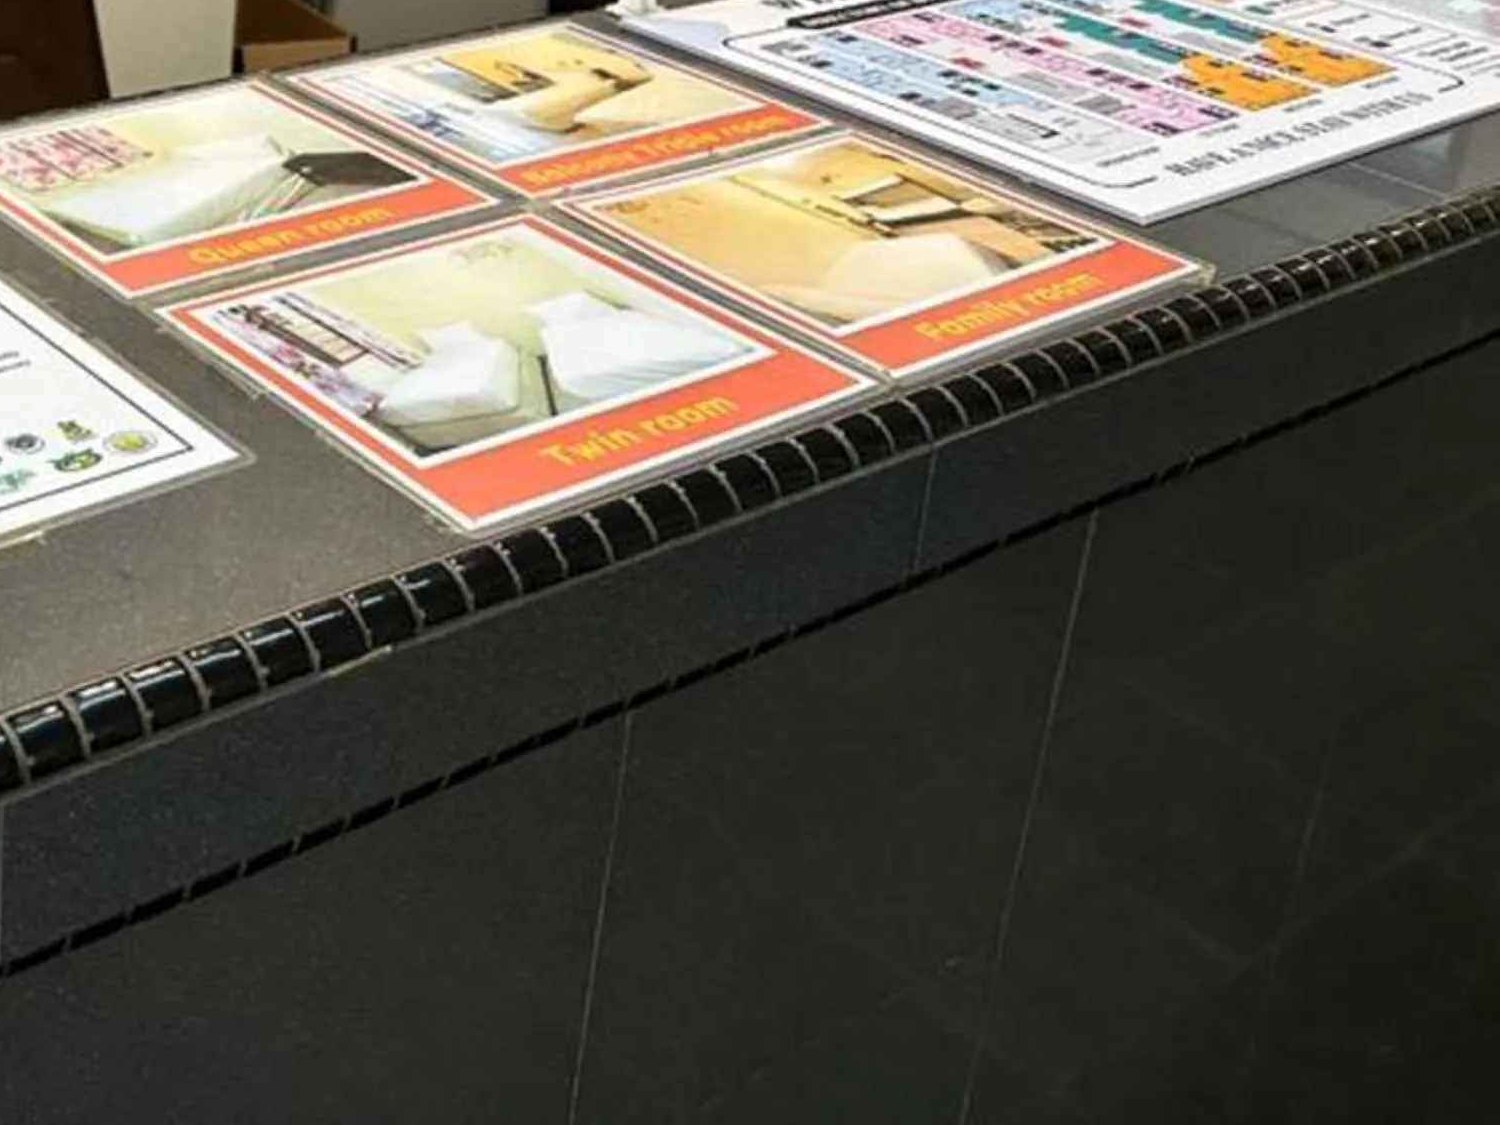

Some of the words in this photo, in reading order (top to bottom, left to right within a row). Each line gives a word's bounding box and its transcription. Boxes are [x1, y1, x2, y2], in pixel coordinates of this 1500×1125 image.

[186, 226, 301, 266] Queen
[301, 204, 398, 237] room
[912, 297, 1032, 343] Family
[1020, 271, 1106, 307] room
[538, 426, 644, 468] Twin
[639, 394, 741, 438] room
